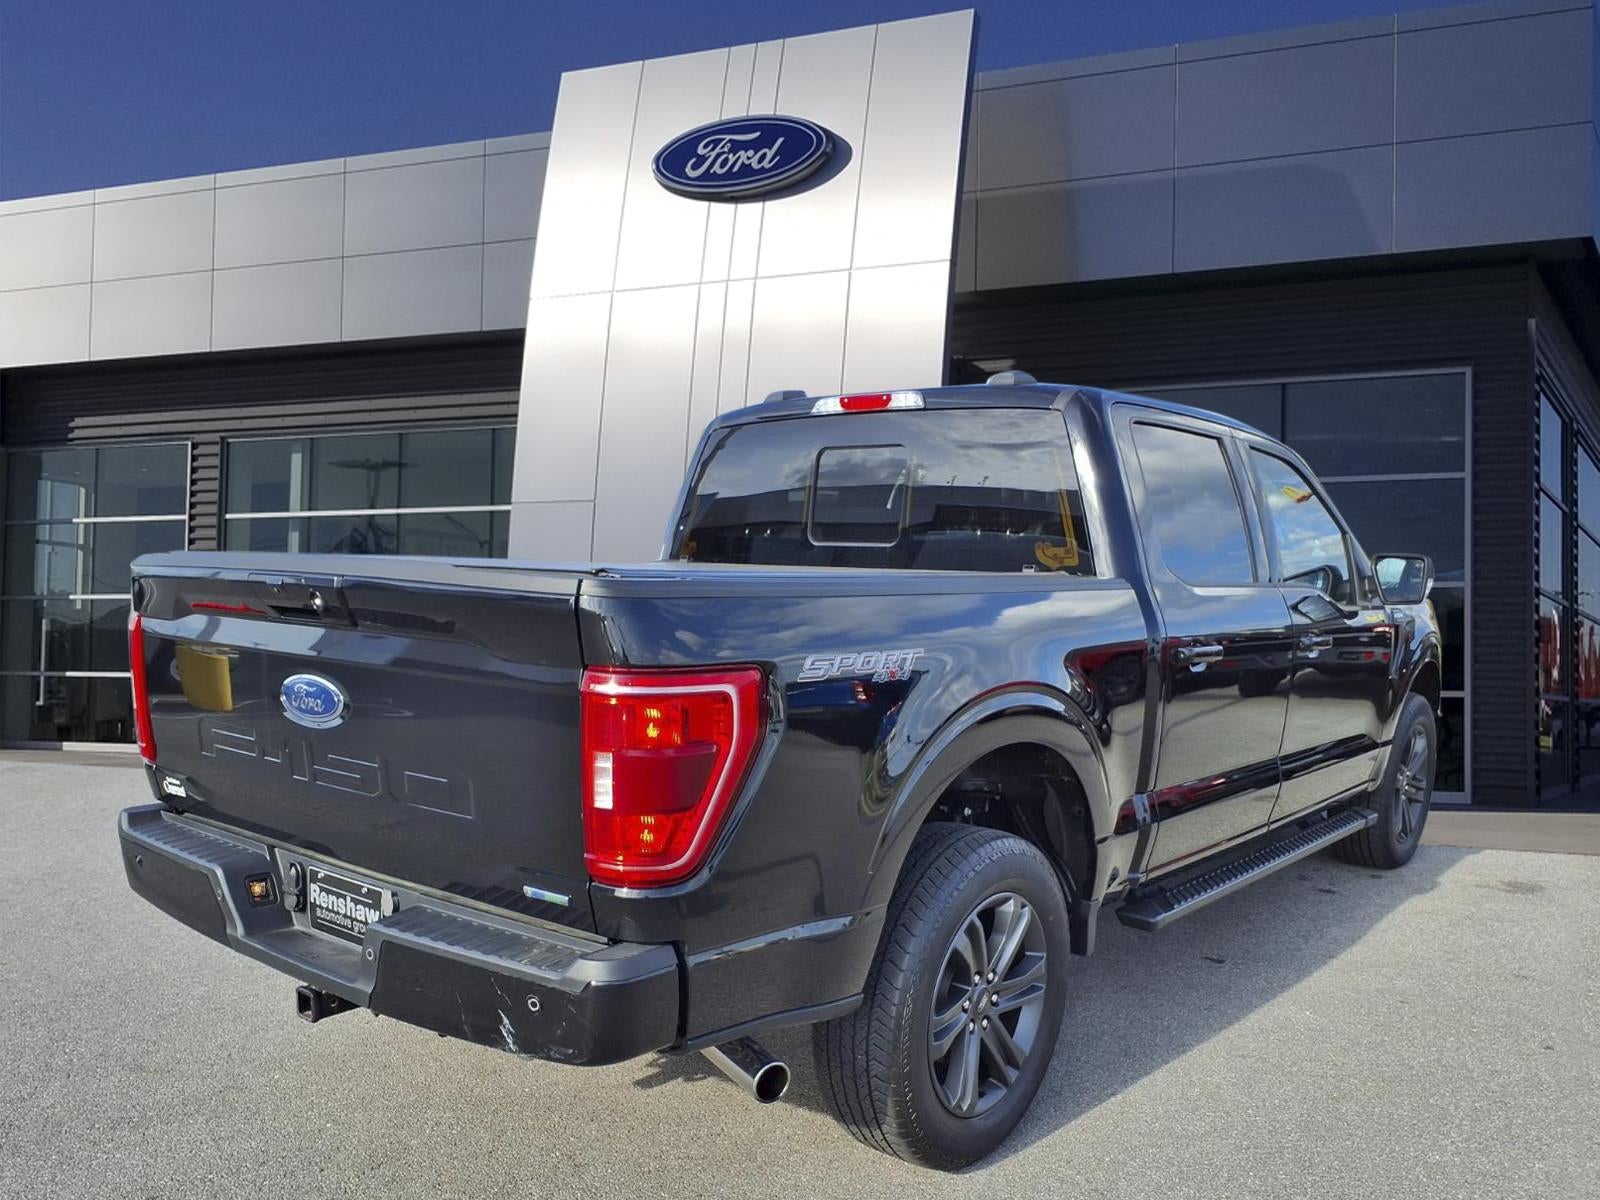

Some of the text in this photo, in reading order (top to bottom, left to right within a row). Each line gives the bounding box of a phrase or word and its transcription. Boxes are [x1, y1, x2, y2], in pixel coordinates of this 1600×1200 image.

[684, 131, 784, 177] Ford
[797, 648, 924, 682] SPORT
[291, 682, 325, 712] Ford
[310, 883, 380, 923] Renshaw
[315, 907, 352, 928] automotive
